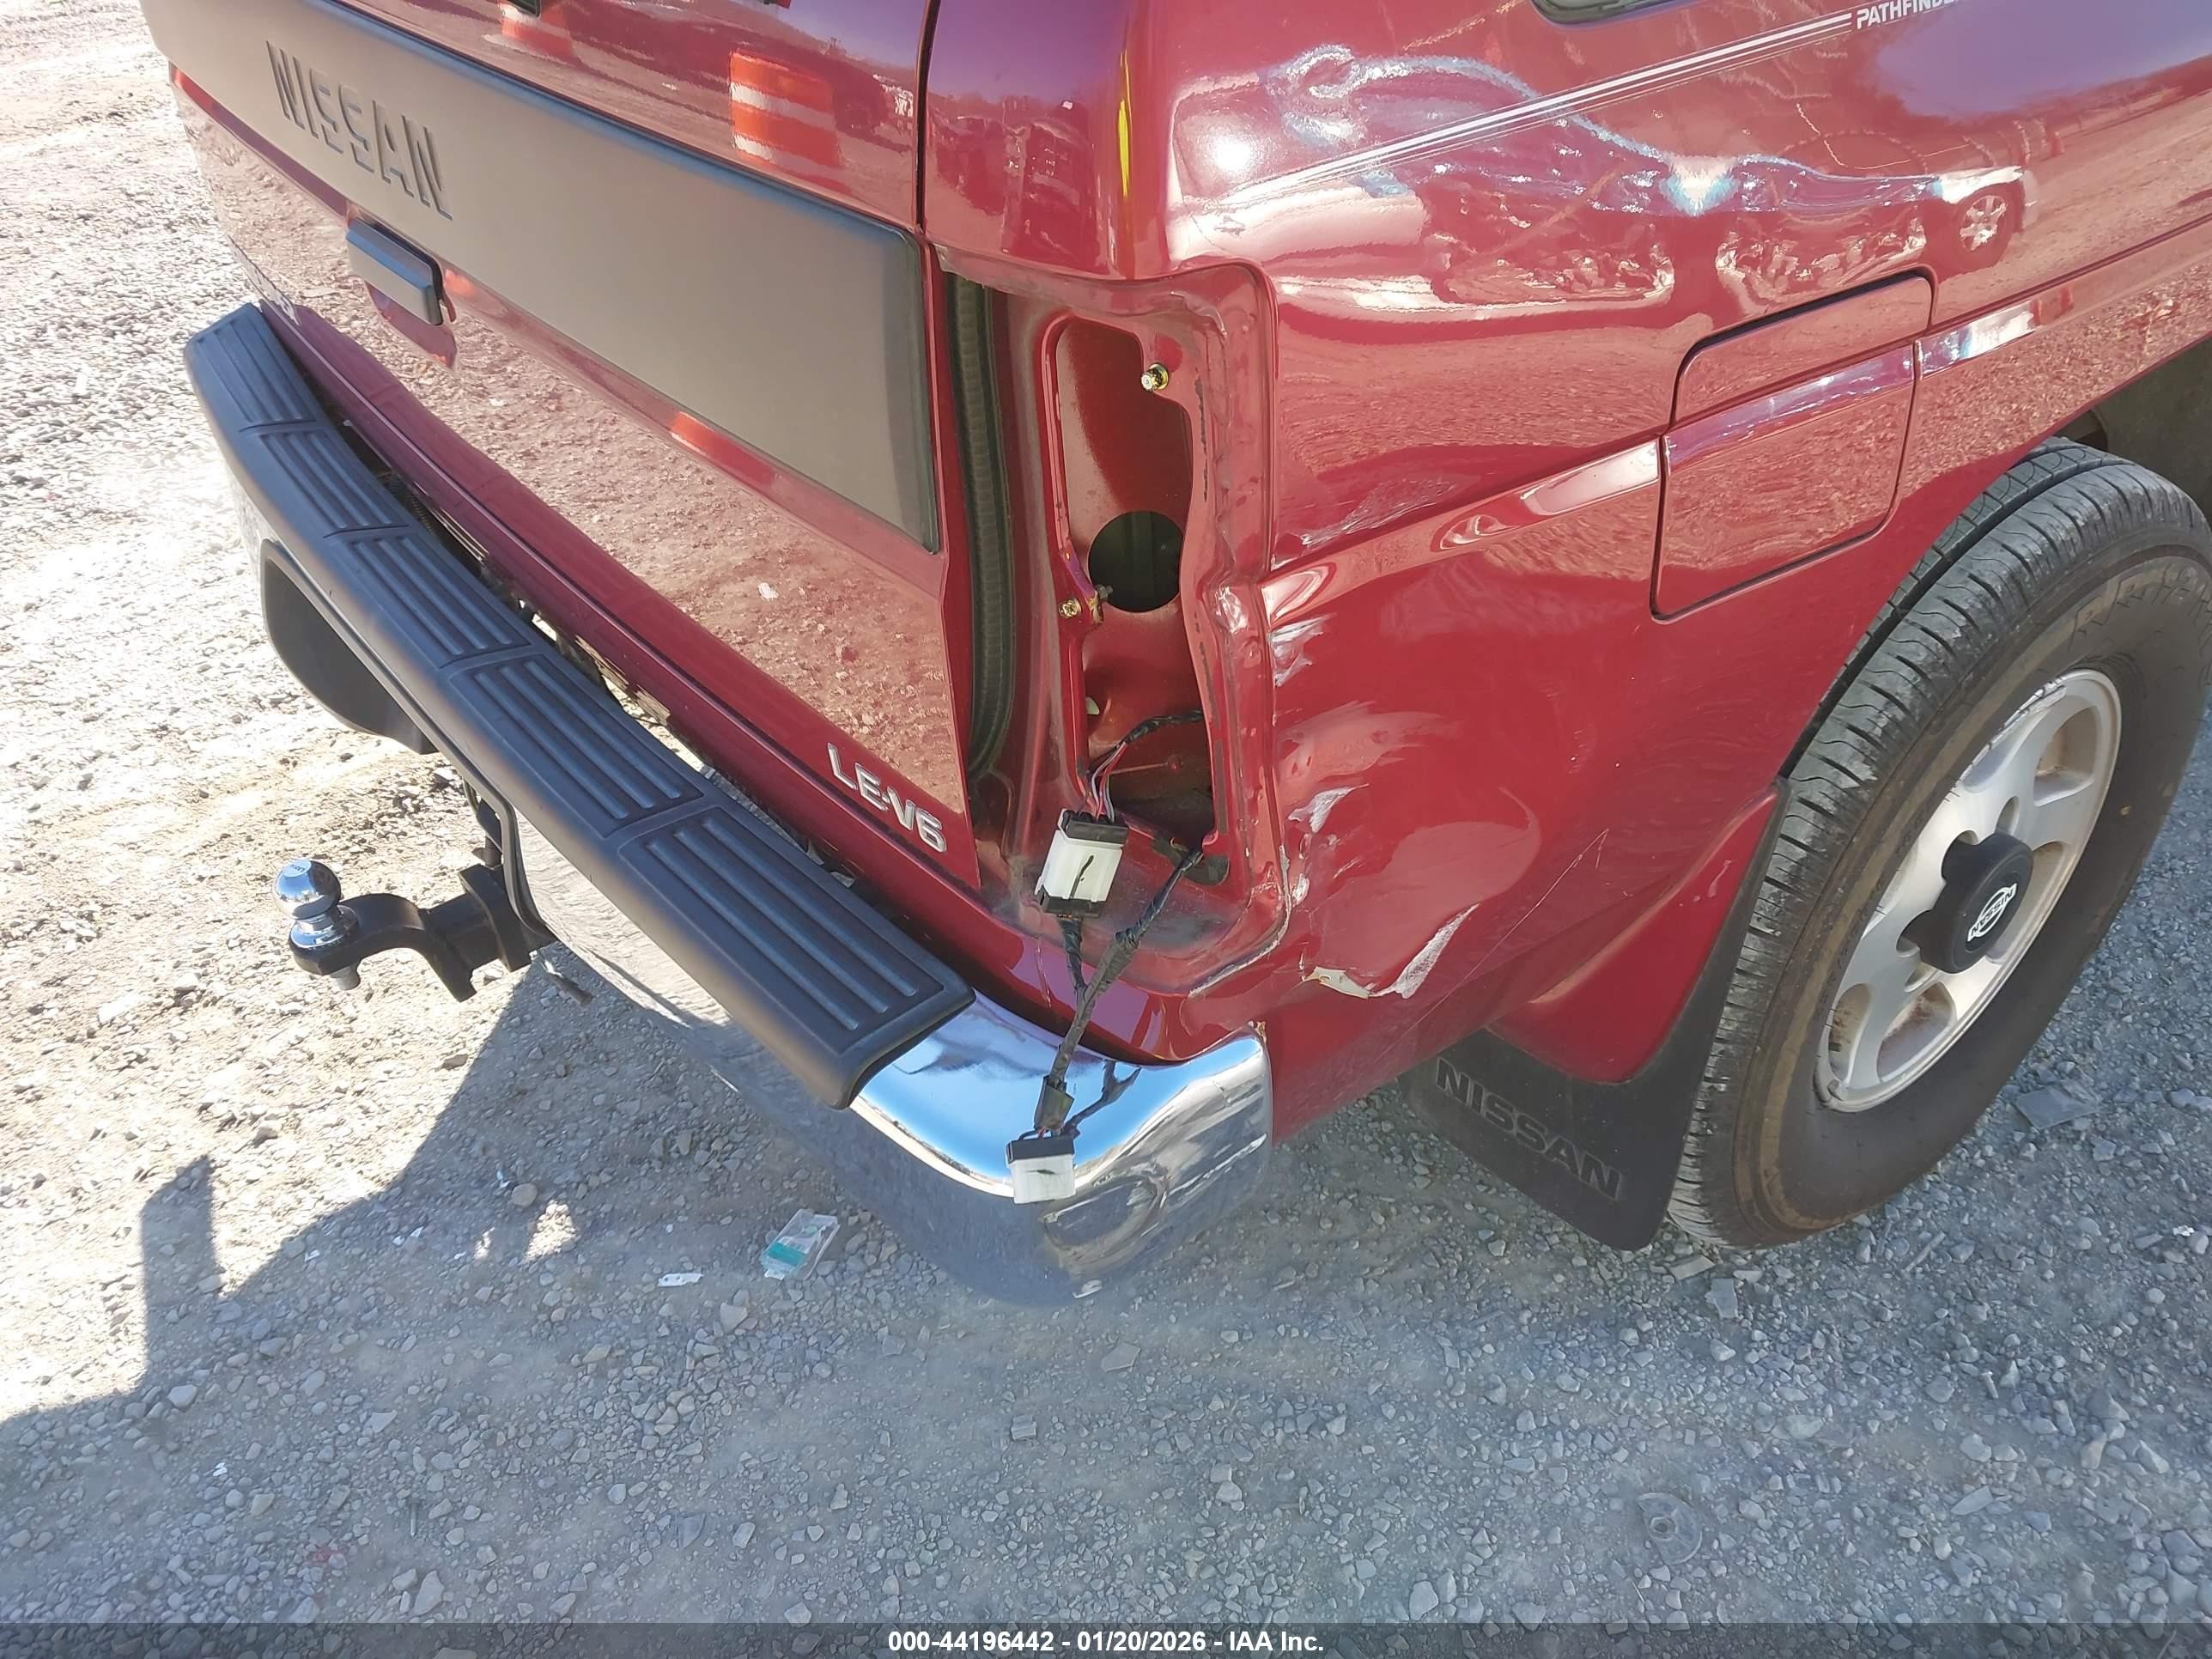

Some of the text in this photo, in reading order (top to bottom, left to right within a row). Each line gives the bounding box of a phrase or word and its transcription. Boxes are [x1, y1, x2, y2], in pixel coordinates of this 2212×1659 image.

[265, 40, 453, 221] NISSAN
[1967, 884, 2017, 941] NISSAN
[1435, 1057, 1623, 1201] NISSAN
